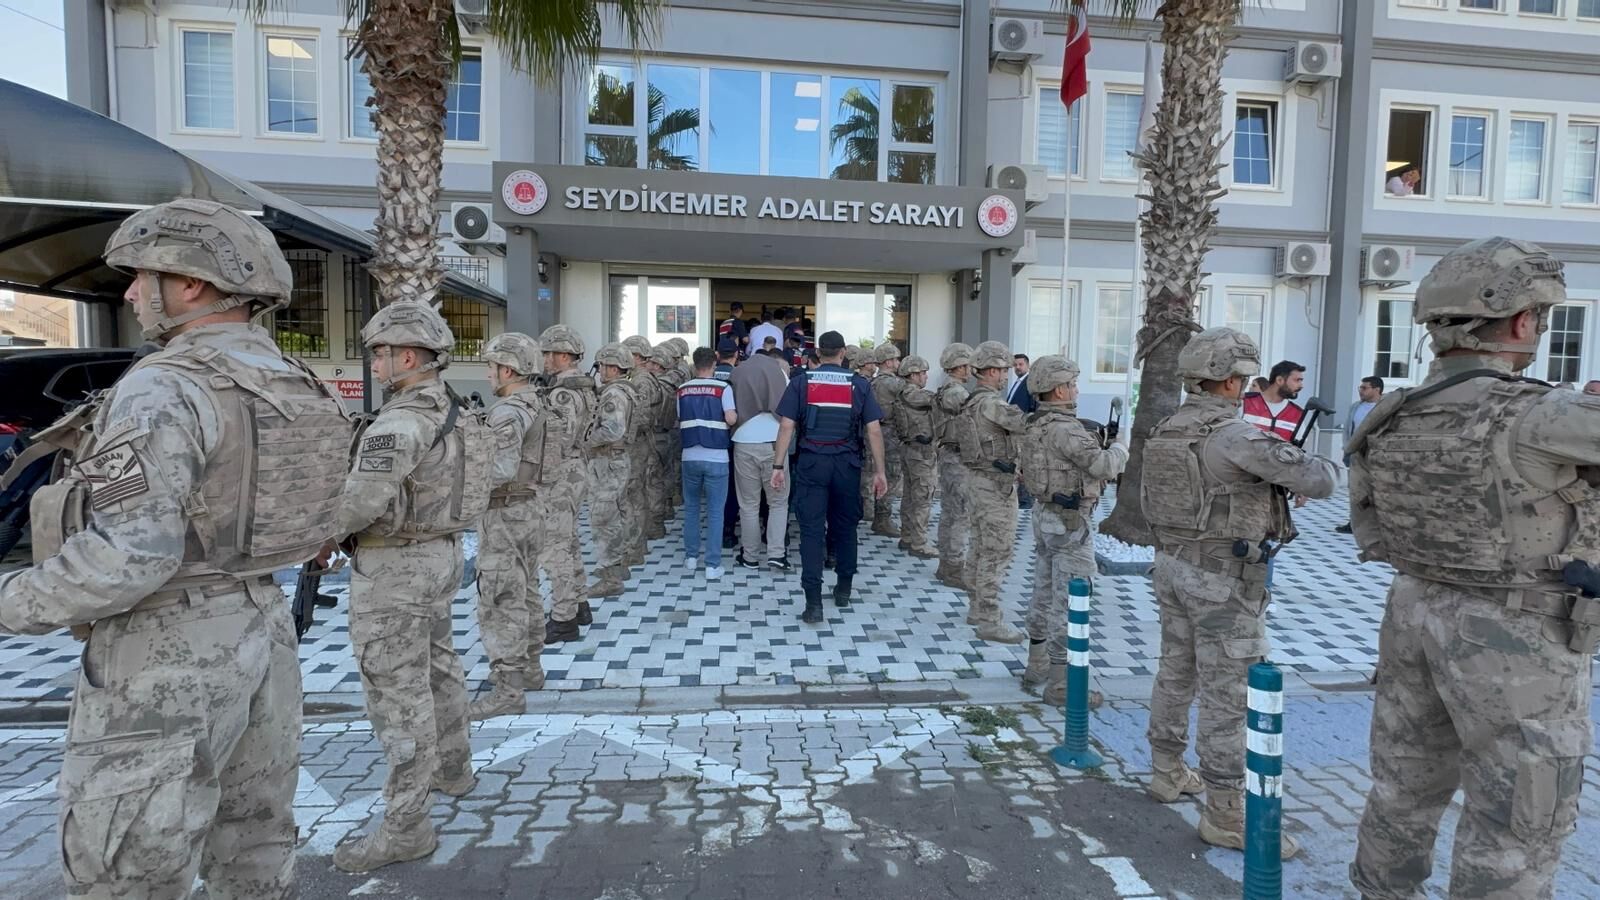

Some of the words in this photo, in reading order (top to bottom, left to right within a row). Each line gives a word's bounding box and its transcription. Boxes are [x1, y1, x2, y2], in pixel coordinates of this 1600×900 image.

[564, 183, 748, 217] SEYDİKEMER
[757, 196, 864, 223] ADALET
[869, 202, 964, 228] SARAYI
[335, 368, 343, 376] P
[811, 373, 848, 382] JANDARMA
[680, 386, 716, 396] JANDARMA
[93, 452, 124, 469] UZMAN
